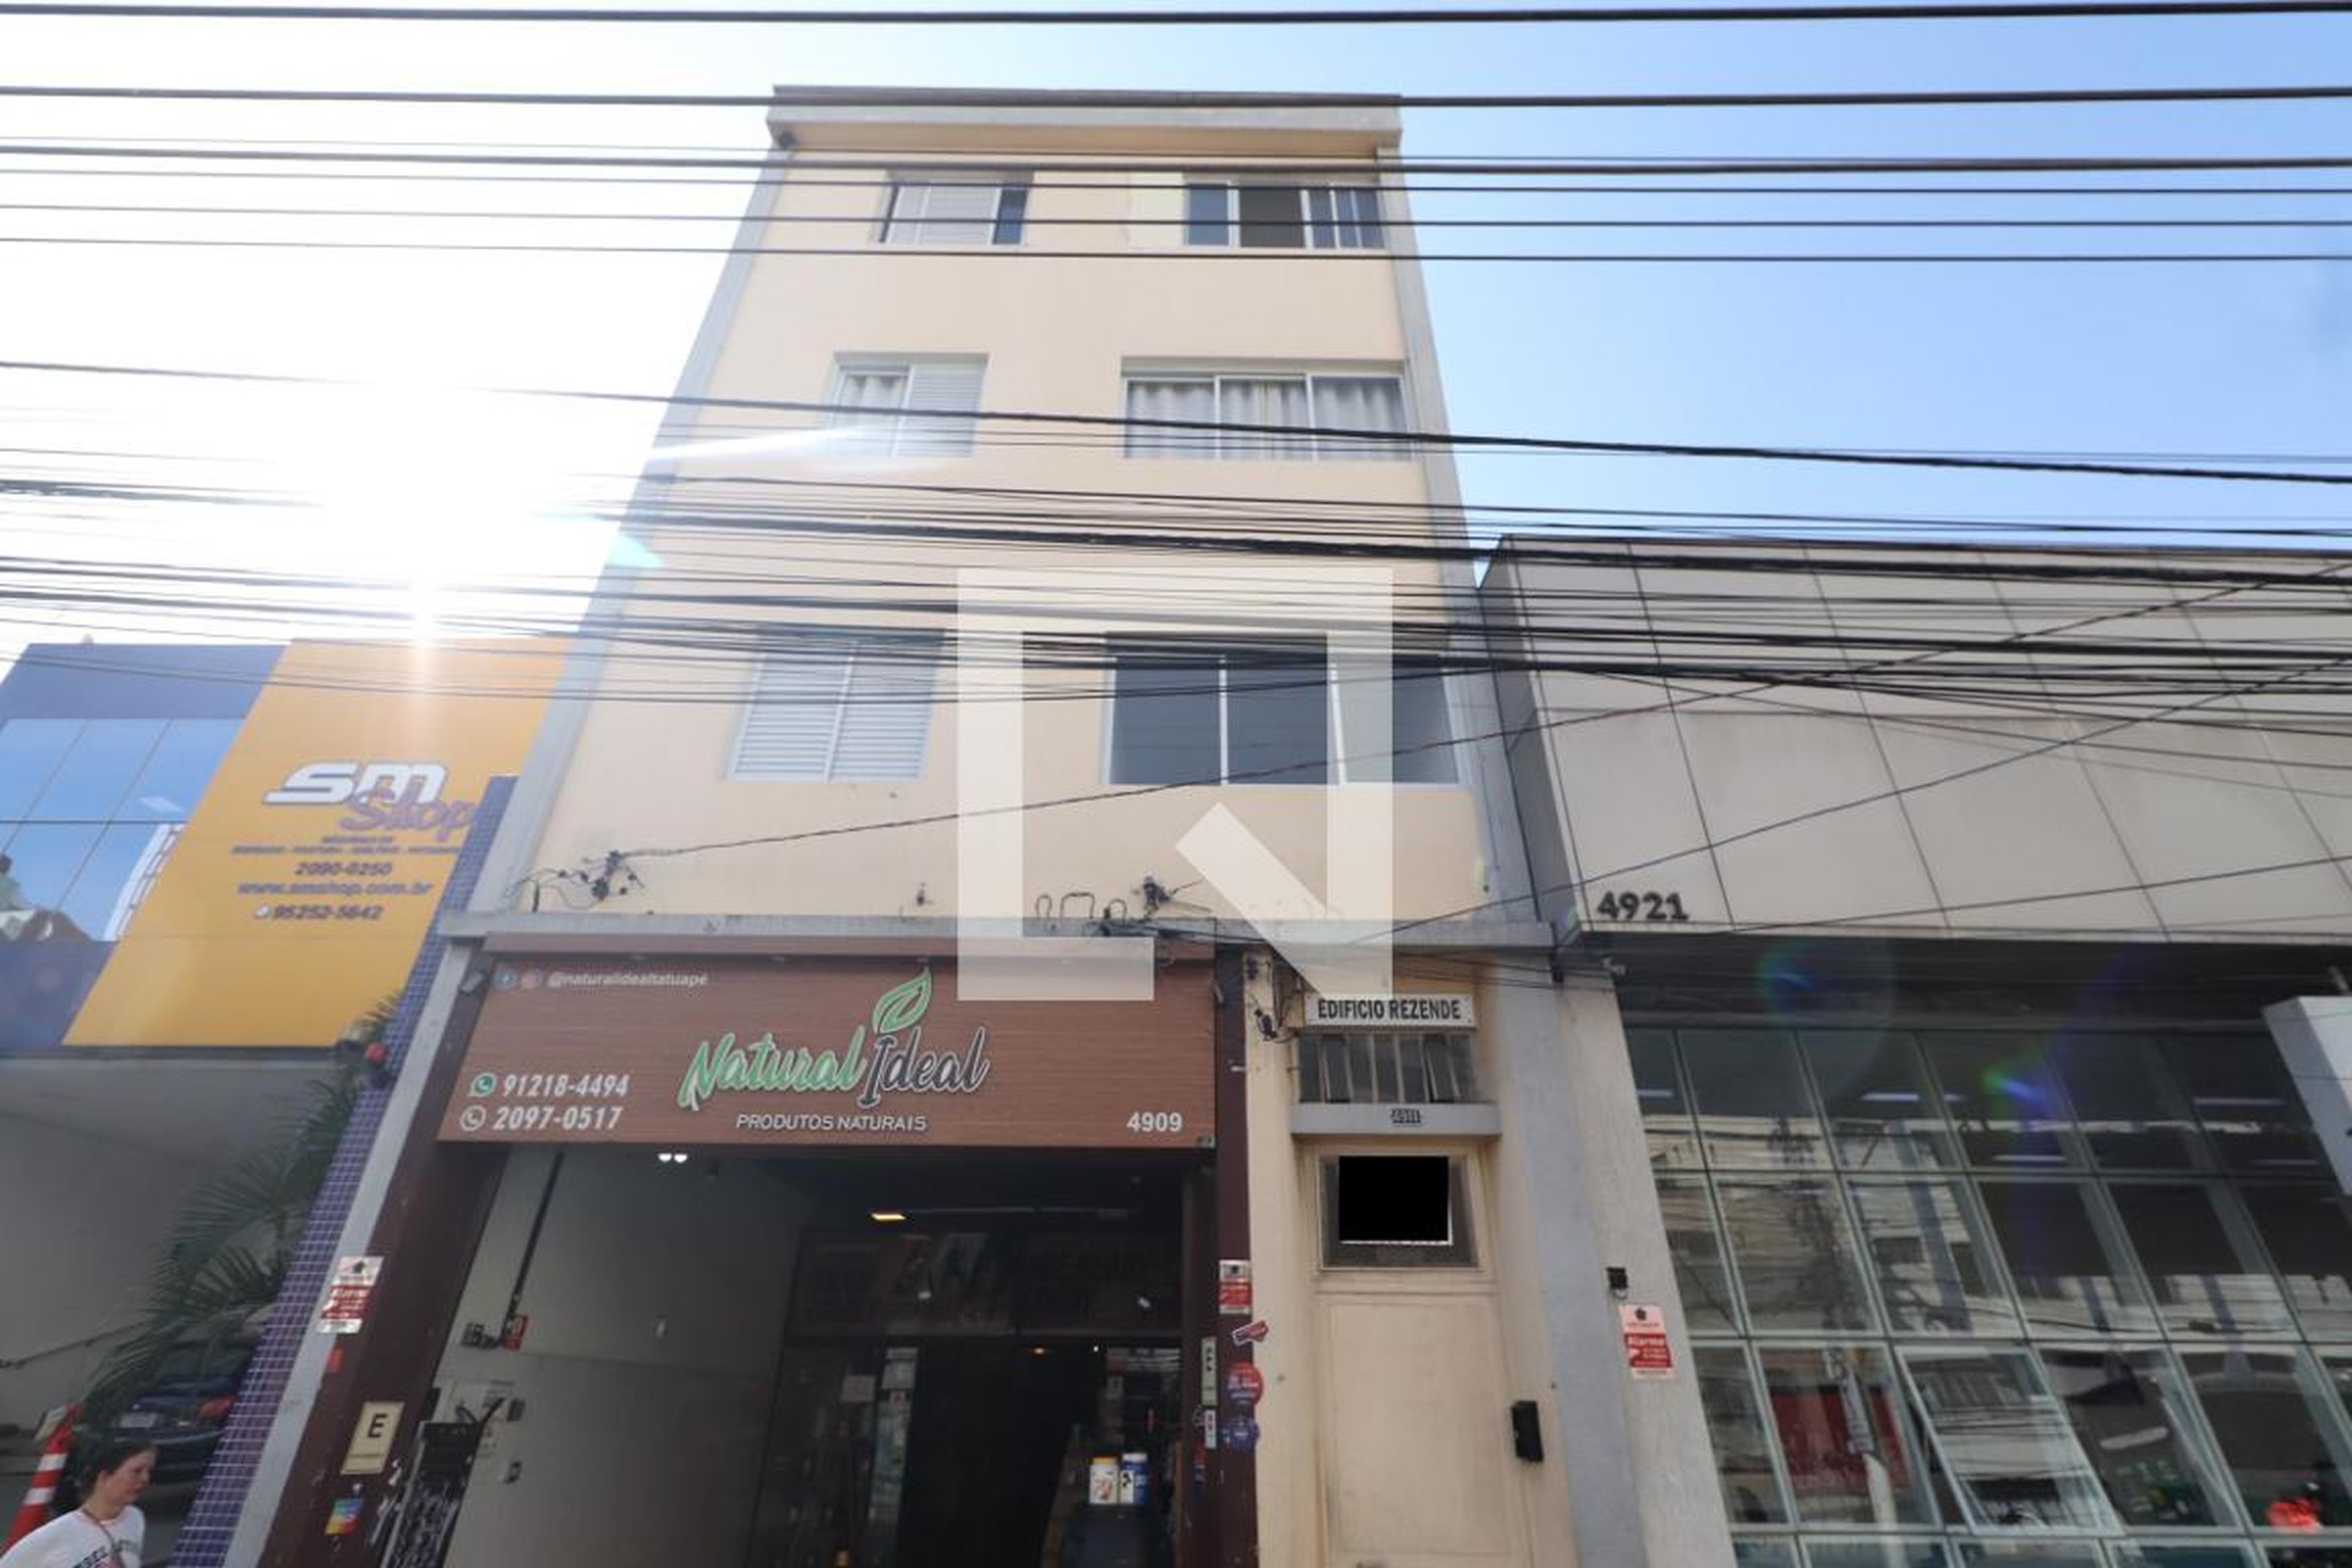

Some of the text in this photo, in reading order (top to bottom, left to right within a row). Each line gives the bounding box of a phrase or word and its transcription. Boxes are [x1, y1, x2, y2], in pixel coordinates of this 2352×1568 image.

[1596, 890, 1689, 921] 4921
[1317, 998, 1462, 1020] EDIFICIO REZENDE
[677, 1025, 992, 1111] Natural Ideal
[501, 1074, 631, 1098] 91218-4494
[492, 1105, 624, 1131] 2097-0517
[736, 1114, 928, 1132] PRODUTOS NATURAIS
[1126, 1110, 1183, 1134] 4909
[368, 1413, 390, 1438] E
